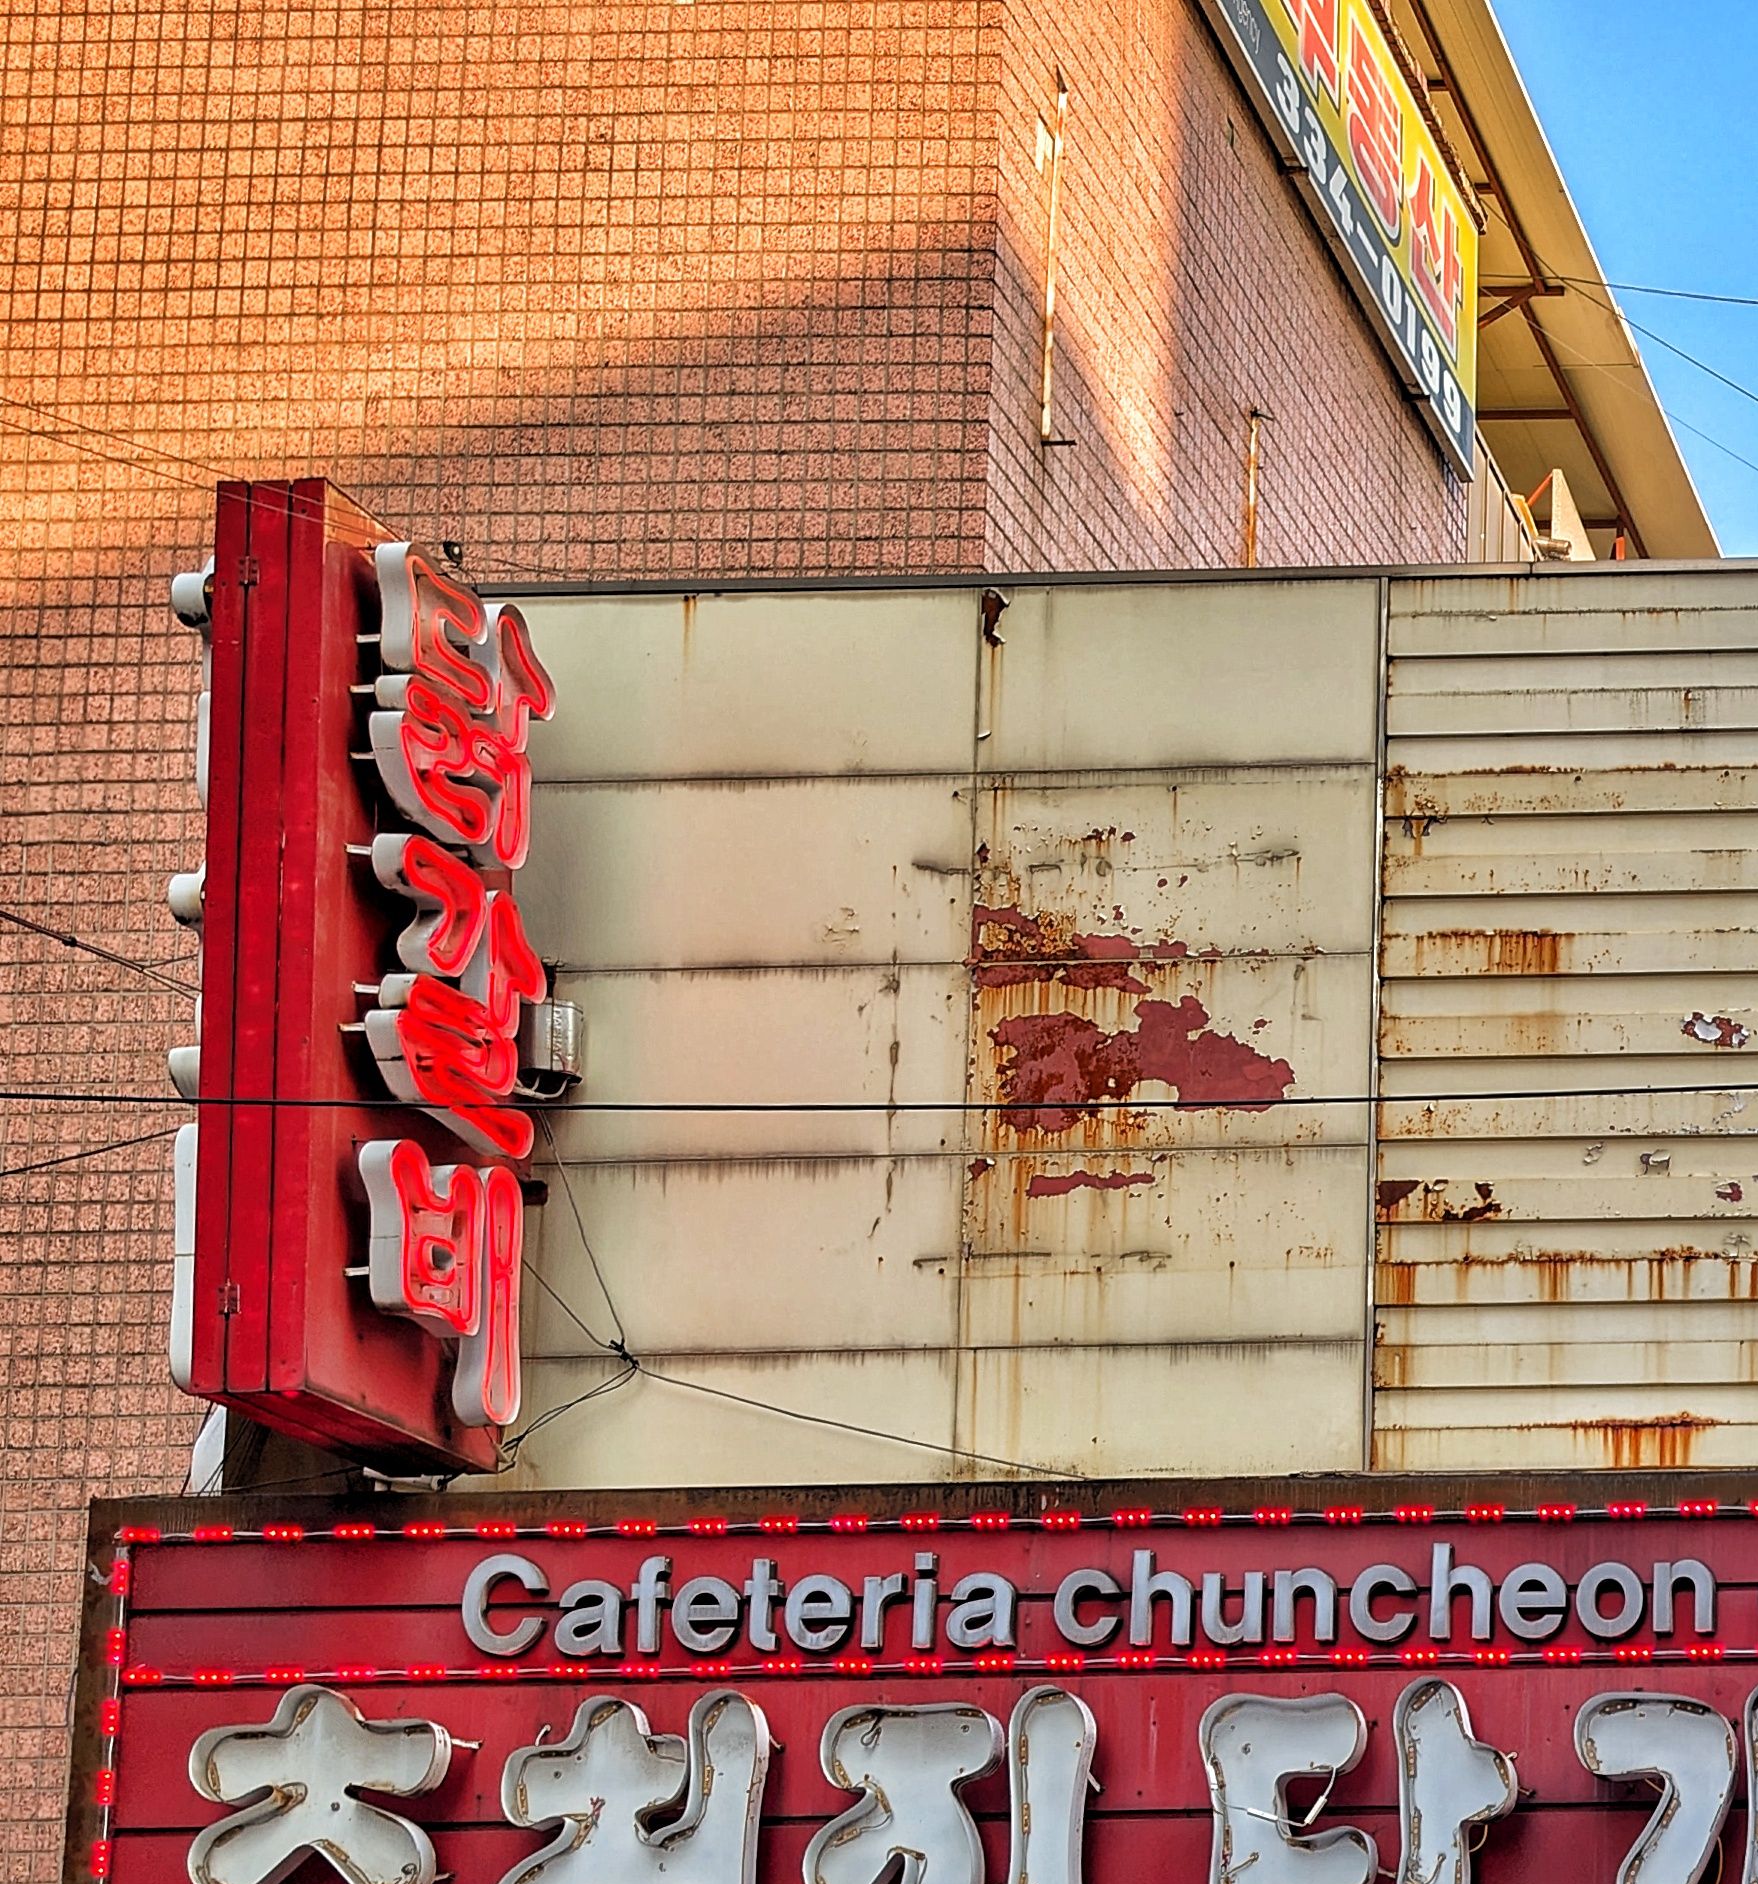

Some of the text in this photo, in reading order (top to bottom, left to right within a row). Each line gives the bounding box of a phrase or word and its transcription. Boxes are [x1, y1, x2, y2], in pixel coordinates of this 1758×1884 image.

[1275, 52, 1463, 434] 334-0199
[376, 540, 556, 1428] 닭갈비
[461, 1550, 1018, 1657] Cafeteria
[1052, 1540, 1717, 1648] chuncheon
